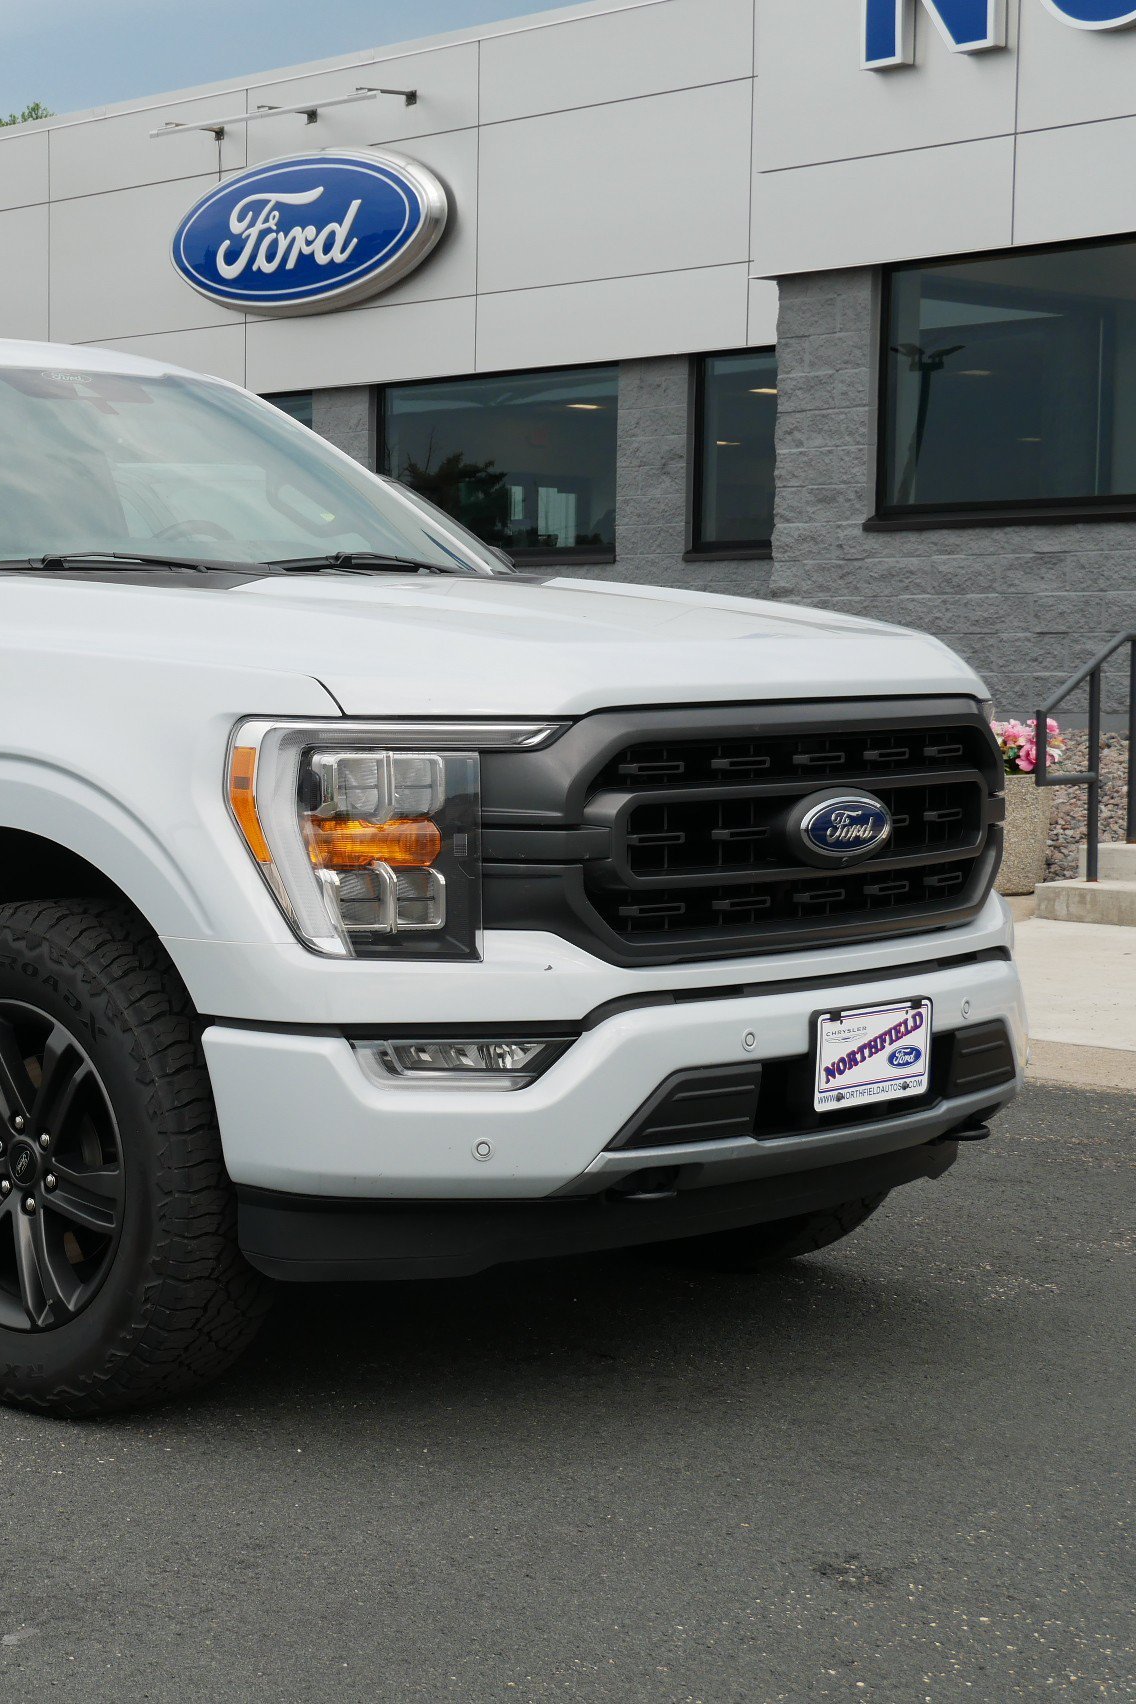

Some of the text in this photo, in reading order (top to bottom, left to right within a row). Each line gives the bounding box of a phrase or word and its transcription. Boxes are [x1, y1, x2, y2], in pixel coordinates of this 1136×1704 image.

[216, 186, 362, 280] Ford
[826, 810, 875, 843] Ford
[825, 1025, 868, 1036] CHRYSLER
[823, 1010, 924, 1084] NORTHFIELD
[892, 1047, 916, 1064] Ford
[817, 1078, 923, 1104] WWWNORTHFIELDAUTOSCOM
